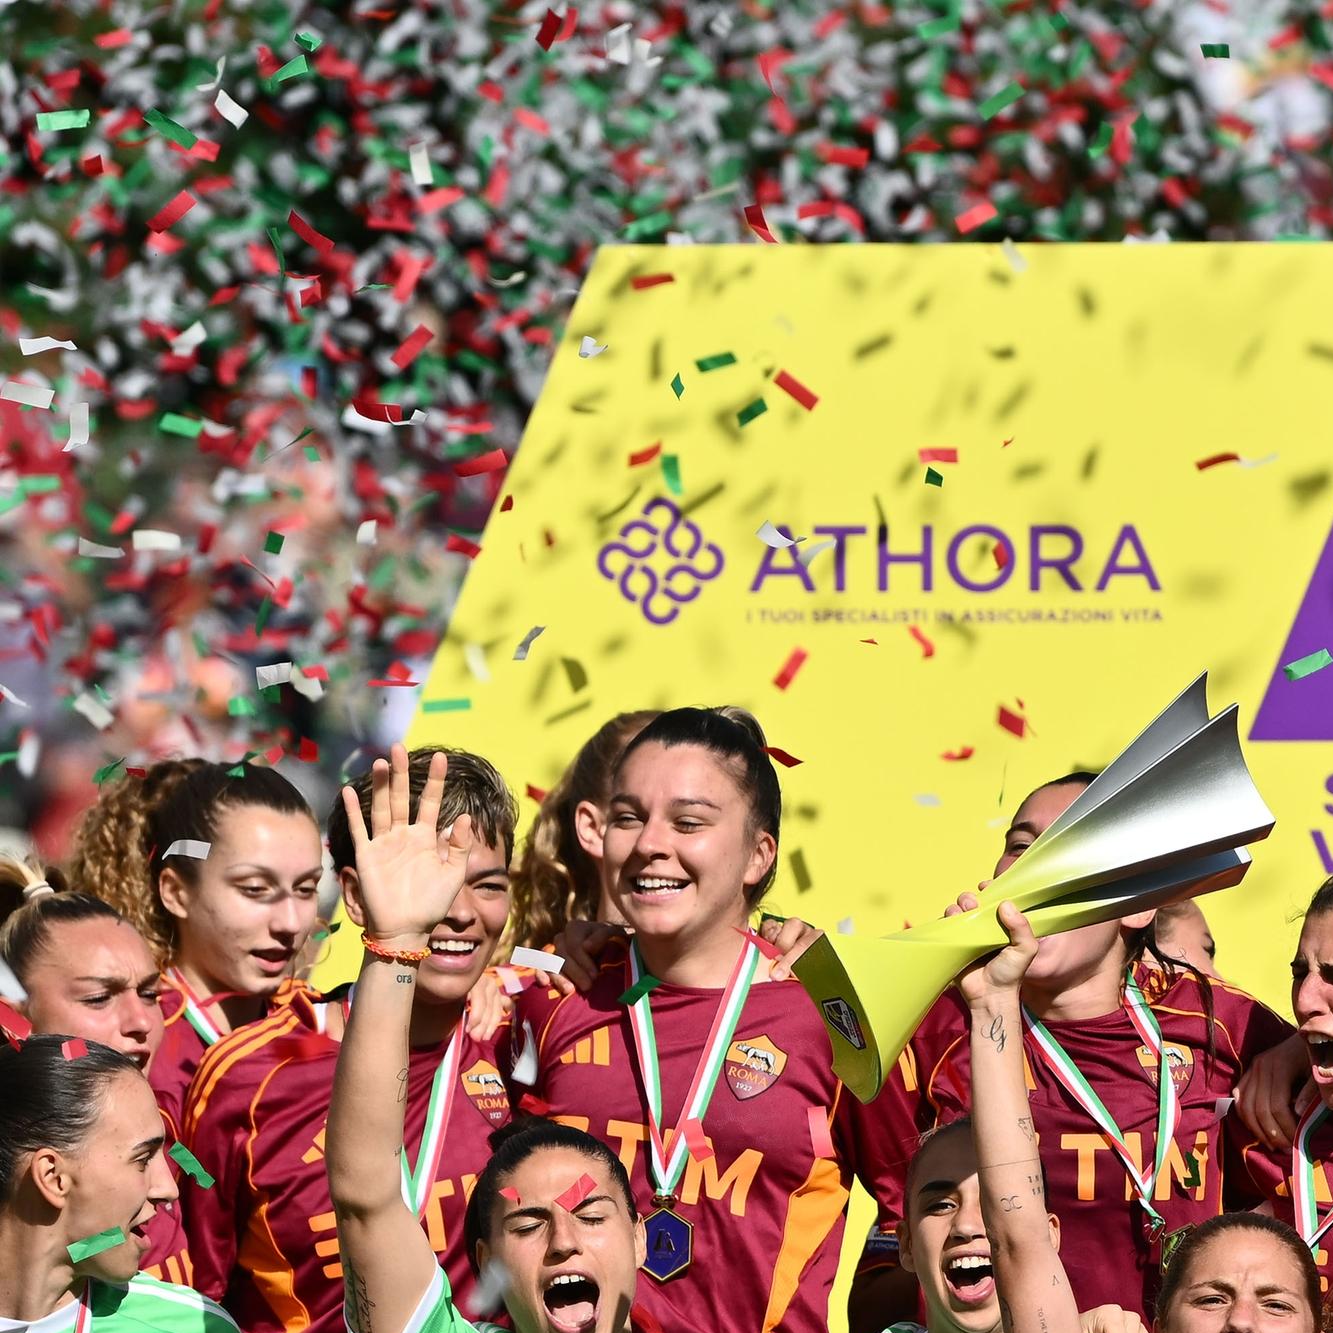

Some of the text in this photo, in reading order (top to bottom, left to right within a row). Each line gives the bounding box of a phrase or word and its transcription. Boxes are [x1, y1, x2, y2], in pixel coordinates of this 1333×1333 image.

[749, 523, 1162, 593] ATHORA
[759, 609, 805, 623] TUOI
[812, 609, 927, 623] SPECIALISTI
[963, 609, 1114, 623] ASSICURAZIONI
[1121, 608, 1163, 622] VITA
[728, 1065, 768, 1087] ROMA
[1151, 1070, 1190, 1081] RMA
[476, 1097, 510, 1110] ROMA
[606, 1119, 764, 1218] TM
